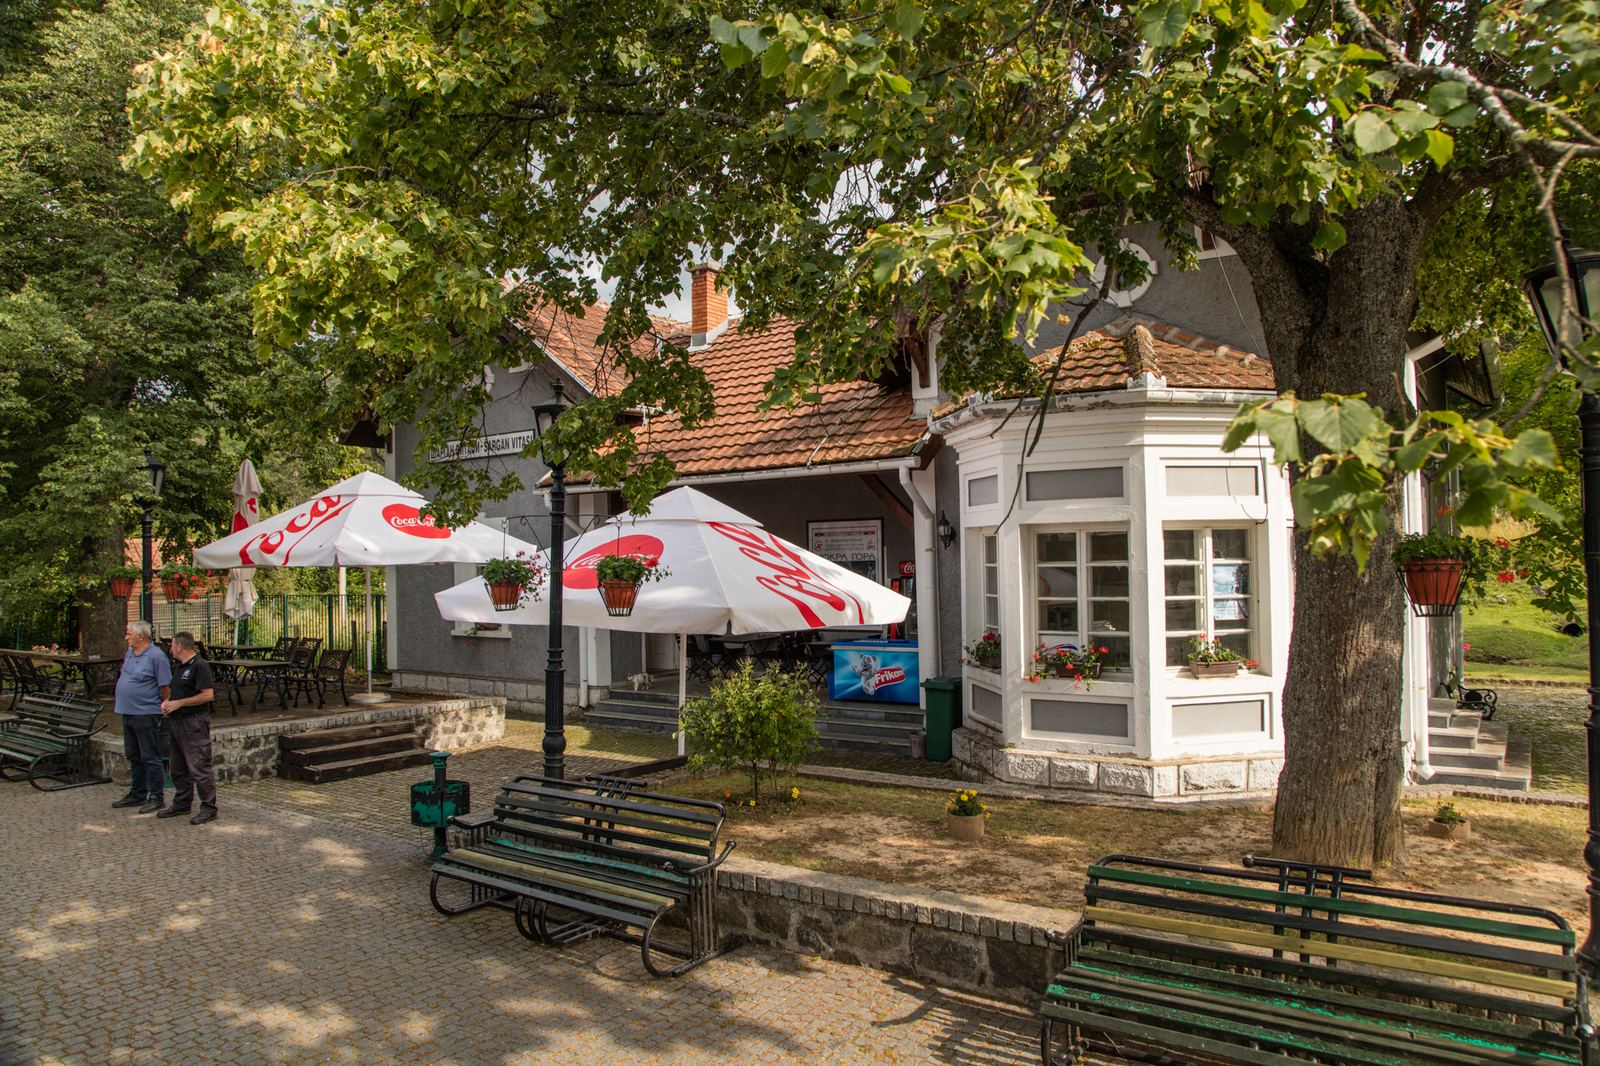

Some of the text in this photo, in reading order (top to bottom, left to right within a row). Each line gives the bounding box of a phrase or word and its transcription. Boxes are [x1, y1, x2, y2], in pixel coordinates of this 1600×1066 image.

[391, 516, 436, 528] Coca-Col
[851, 552, 876, 560] ГОРА
[873, 669, 905, 684] Frikom
